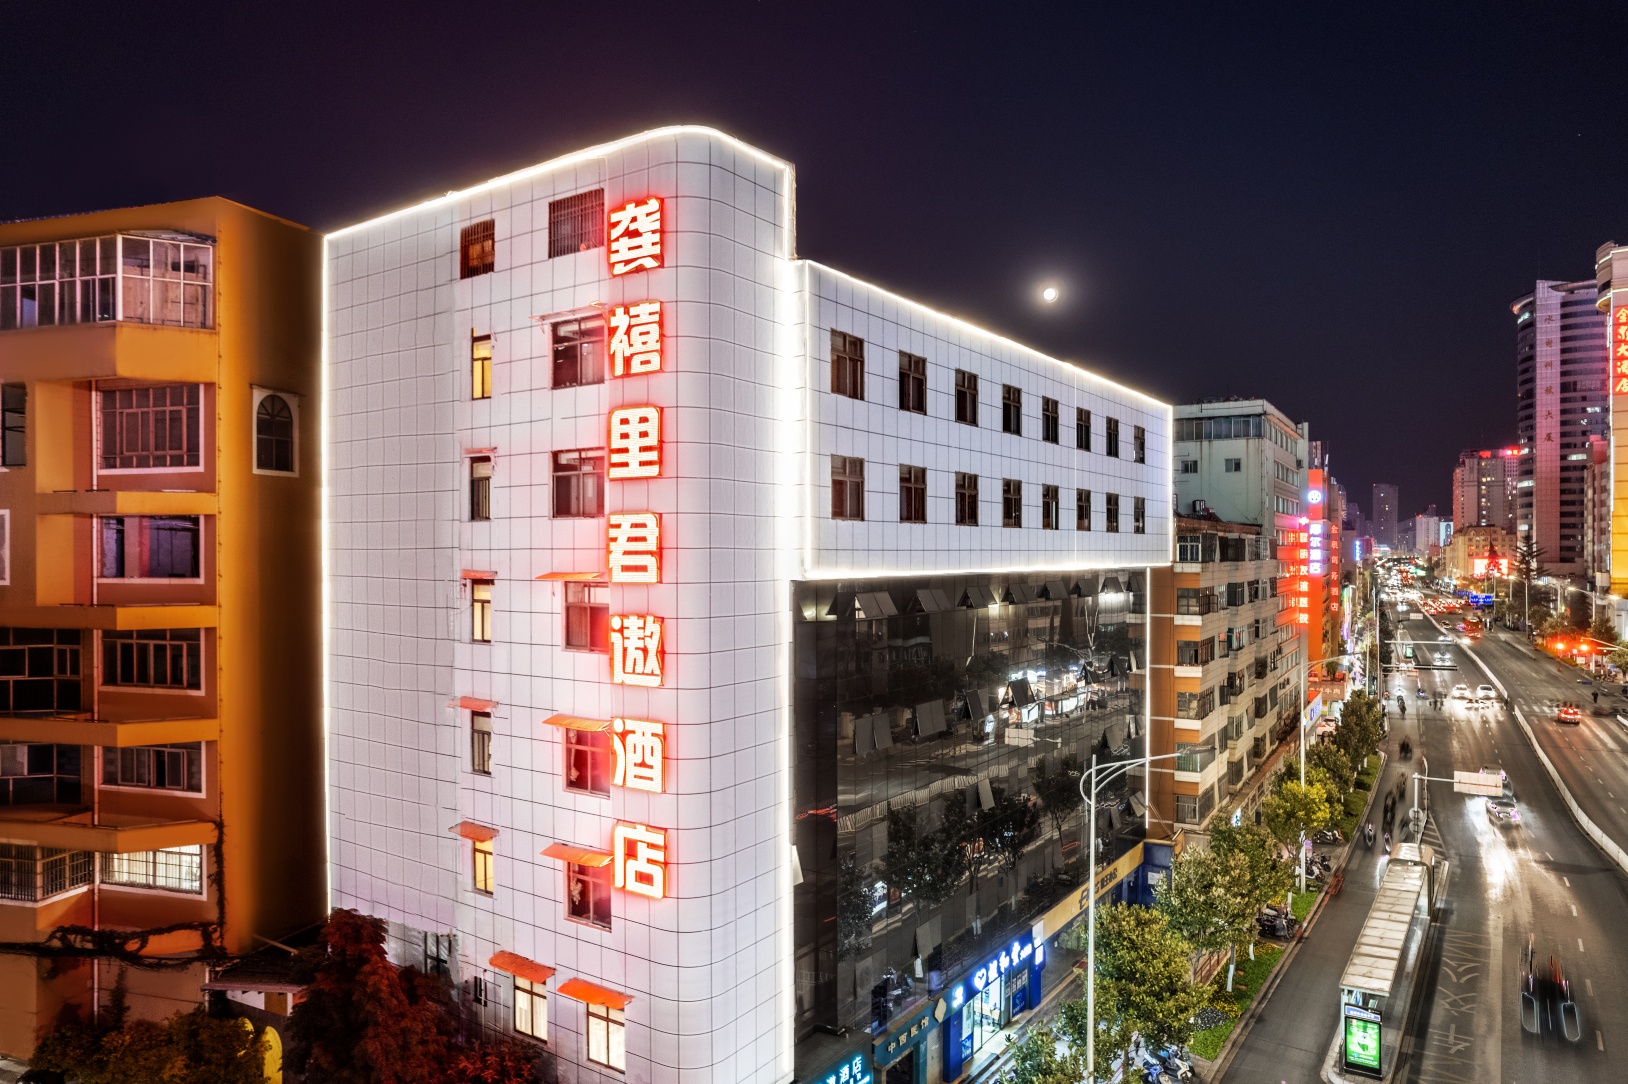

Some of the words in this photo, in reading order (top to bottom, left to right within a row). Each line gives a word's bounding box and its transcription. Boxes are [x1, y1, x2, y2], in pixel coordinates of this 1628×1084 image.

[608, 197, 667, 899] 龚禧里君遨酒店
[888, 1016, 929, 1054] 中西医馆
